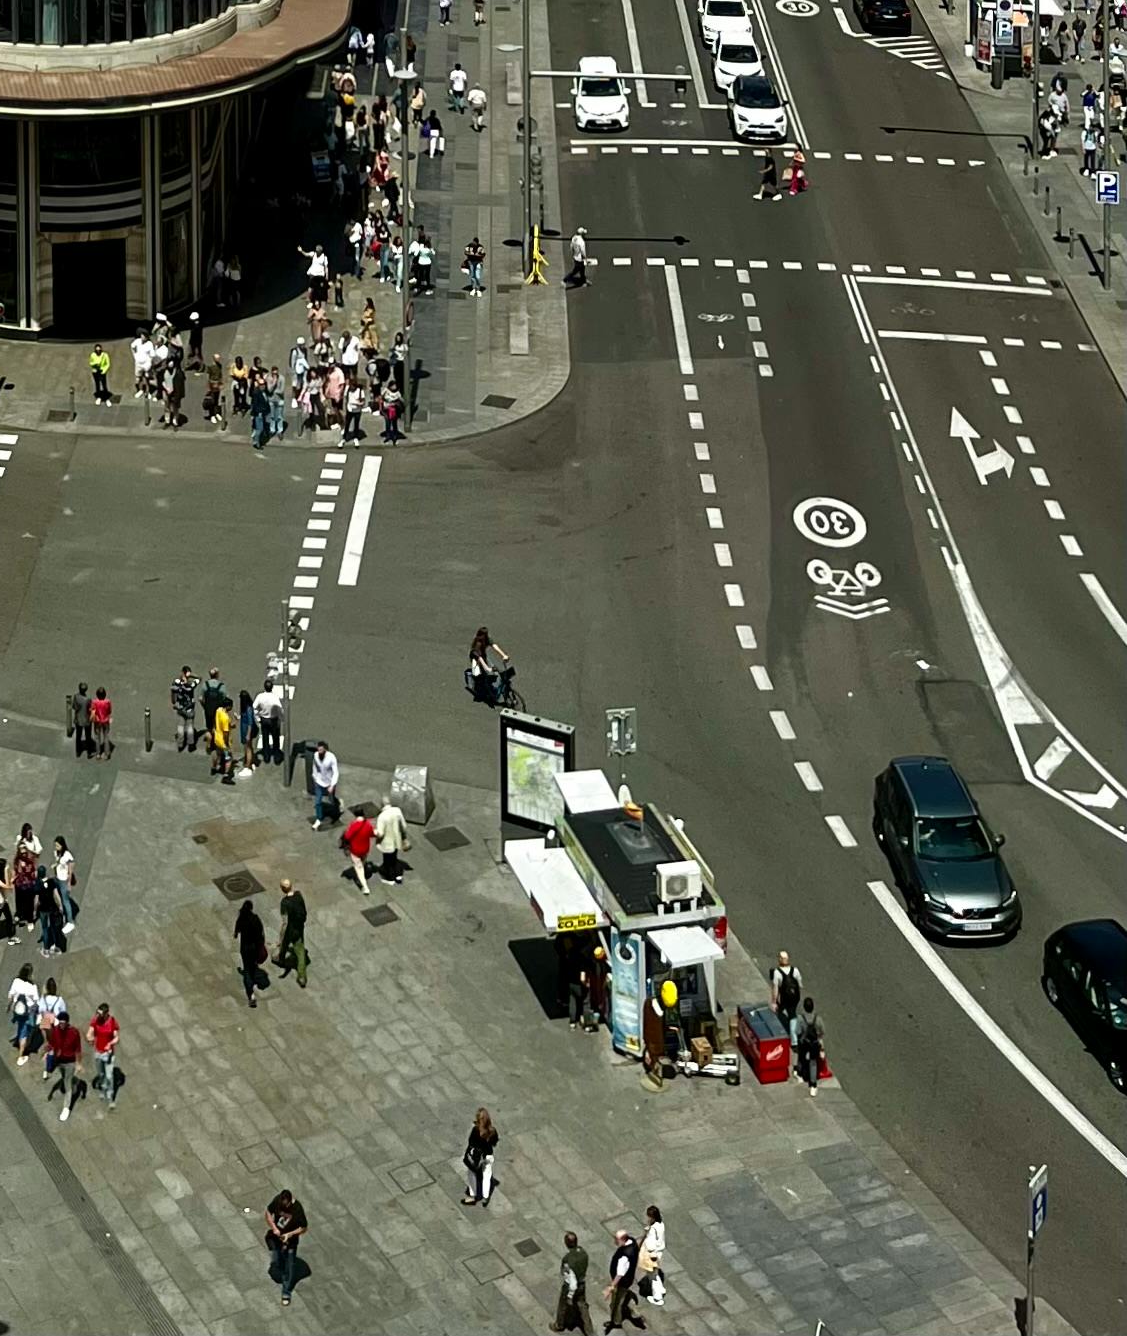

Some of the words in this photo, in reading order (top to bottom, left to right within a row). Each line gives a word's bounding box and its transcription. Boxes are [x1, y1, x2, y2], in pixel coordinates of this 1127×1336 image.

[786, 2, 810, 12] 30
[999, 21, 1011, 37] P
[1099, 173, 1117, 193] P
[810, 510, 850, 535] 30
